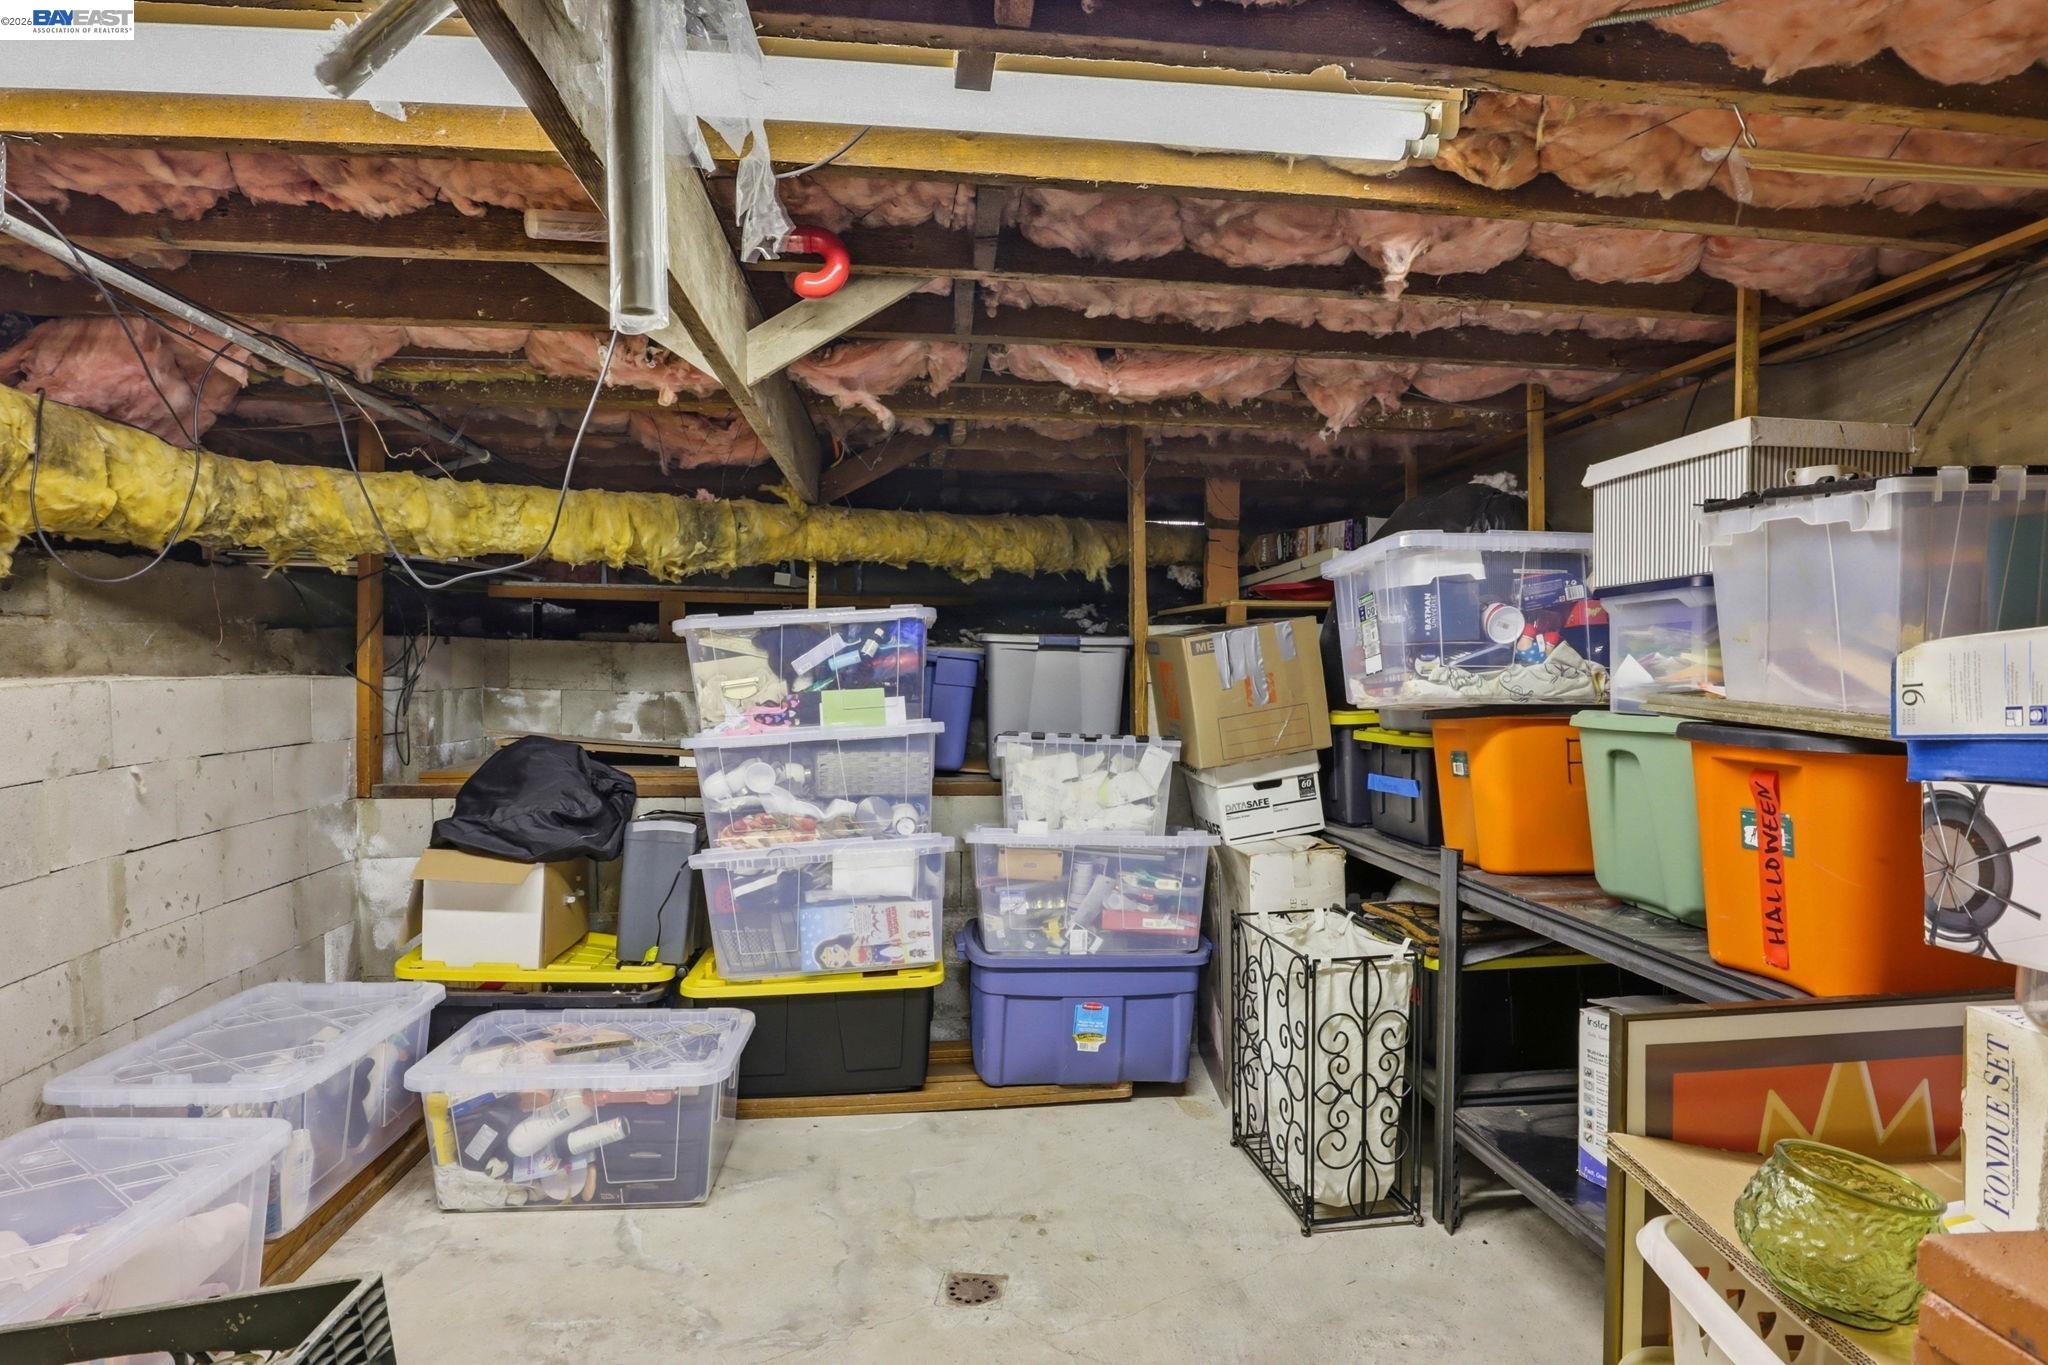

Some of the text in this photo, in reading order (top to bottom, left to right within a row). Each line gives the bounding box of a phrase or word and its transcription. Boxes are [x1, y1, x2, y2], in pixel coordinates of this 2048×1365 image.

[1424, 593, 1432, 630] BATMAN
[1901, 682, 1927, 706] 16
[1225, 797, 1270, 813] DATASAFE
[1754, 780, 1786, 946] HALLOWEEN
[1983, 1032, 2010, 1219] FONDUE SET
